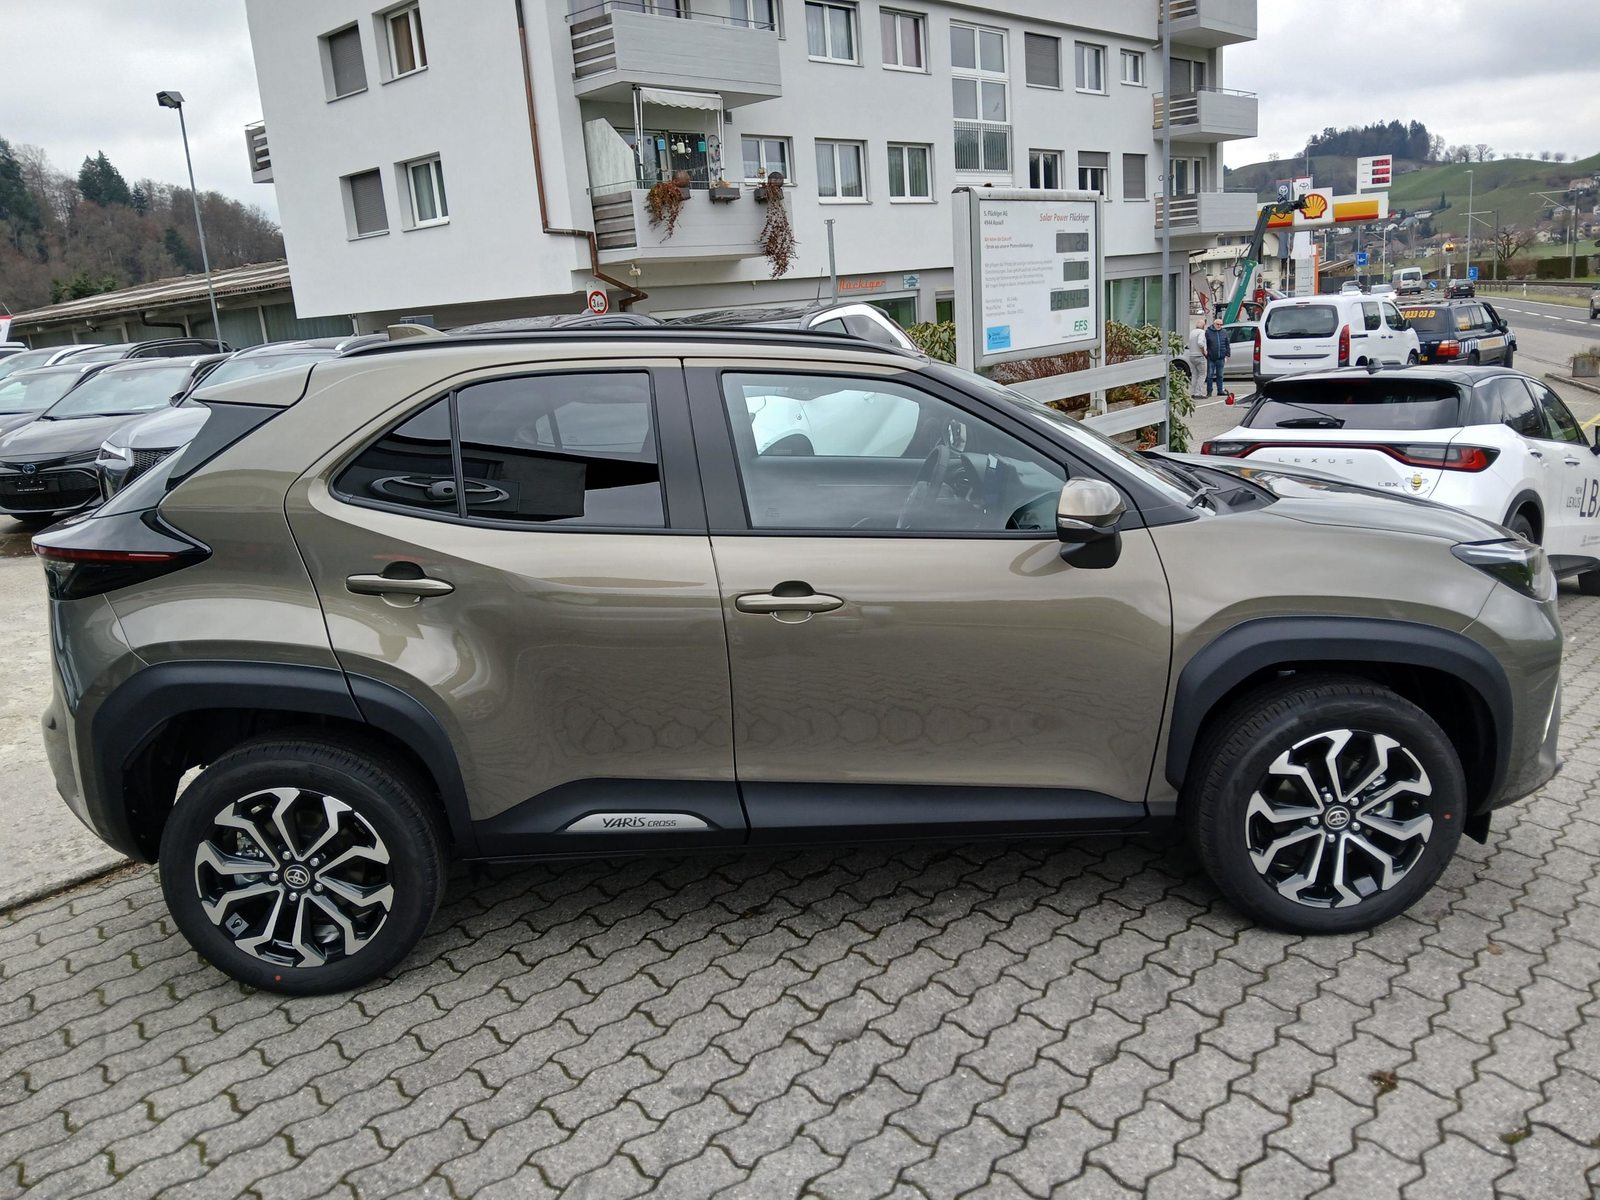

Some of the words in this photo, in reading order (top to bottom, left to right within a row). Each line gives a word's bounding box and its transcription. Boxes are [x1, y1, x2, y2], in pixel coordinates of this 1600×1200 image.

[1039, 213, 1053, 222] Solar
[1053, 213, 1068, 222] Power
[1069, 213, 1090, 223] Flückiger
[1278, 457, 1354, 465] LEXUS
[1579, 477, 1600, 518] LB
[647, 819, 677, 828] CROSS
